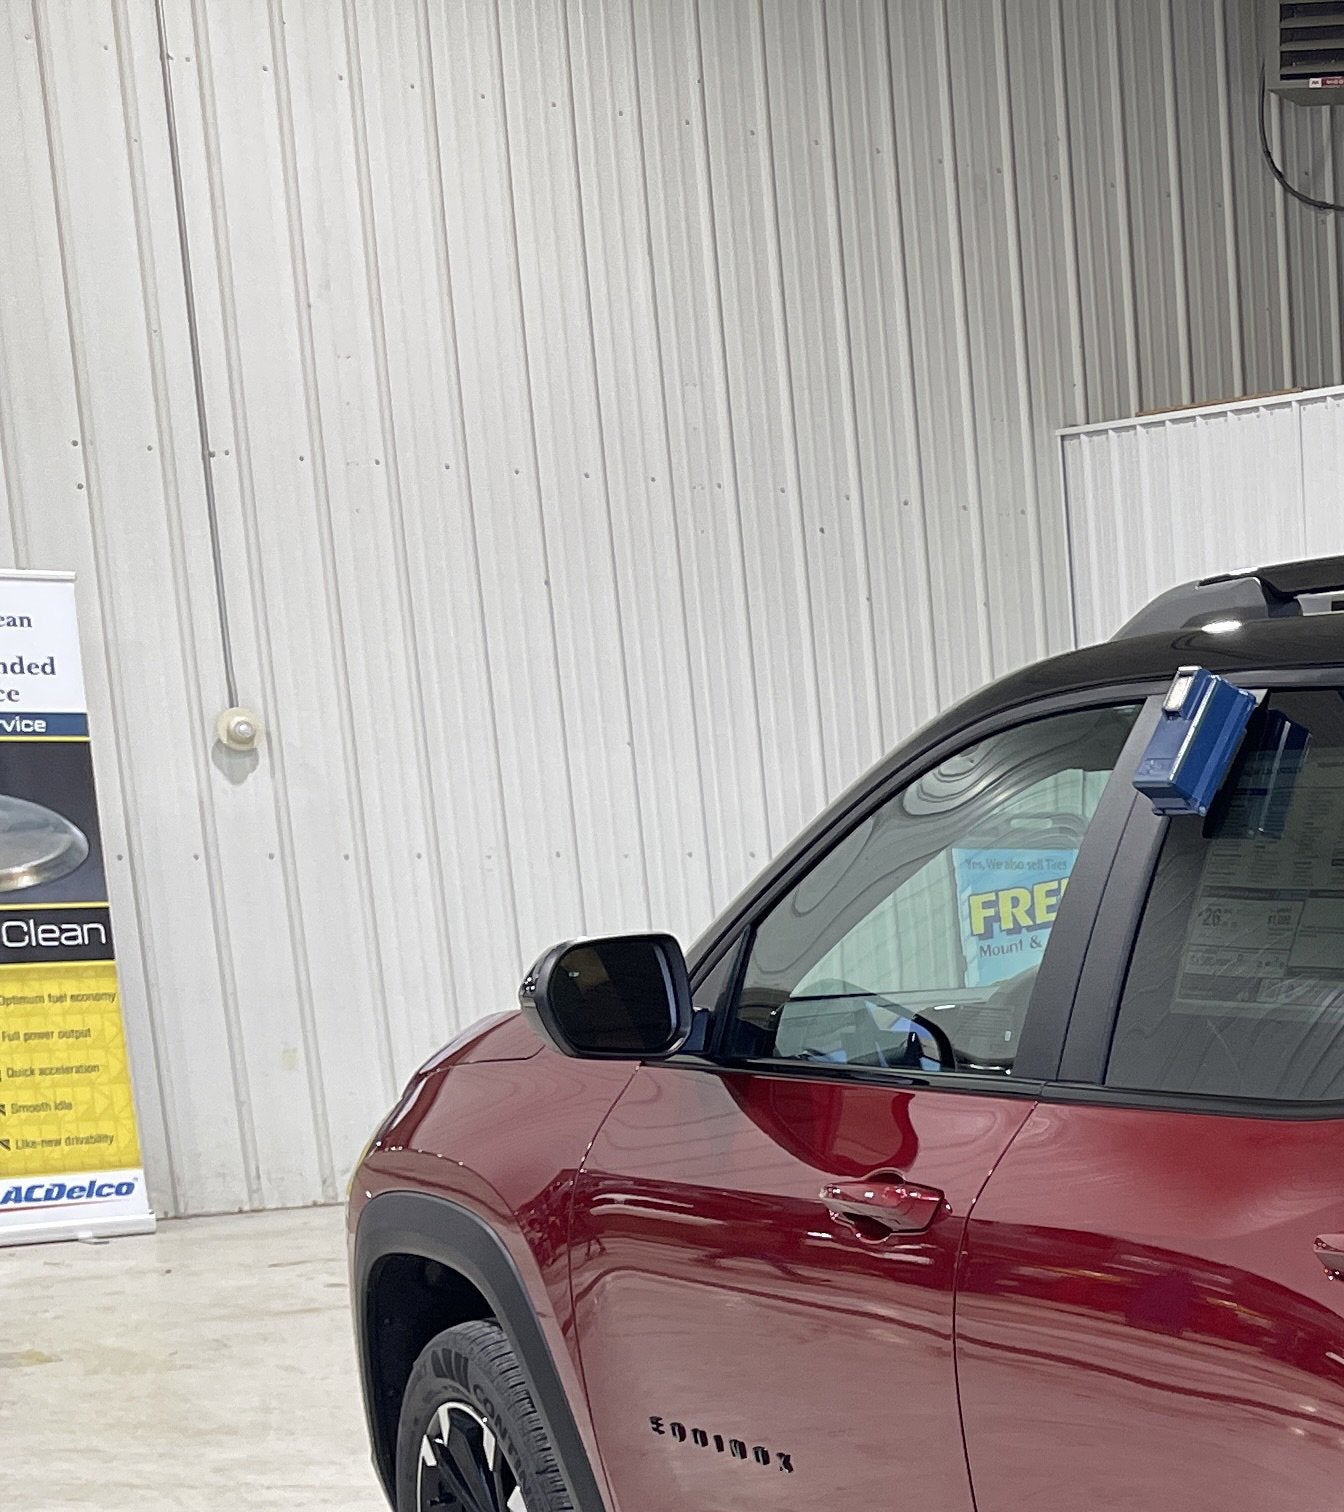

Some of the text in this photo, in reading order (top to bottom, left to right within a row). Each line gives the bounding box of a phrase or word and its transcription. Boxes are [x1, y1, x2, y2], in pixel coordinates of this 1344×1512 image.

[1003, 858, 1024, 870] also
[1027, 858, 1043, 870] sell
[1044, 858, 1067, 871] Tires
[968, 877, 1070, 938] FRE
[1, 919, 107, 948] Clean
[979, 935, 1043, 958] Mount &
[47, 993, 68, 1003] fuel
[70, 992, 117, 1003] economy
[1, 1027, 91, 1043] Full power output
[6, 1064, 100, 1079] Quick acceleration
[10, 1102, 52, 1115] Smooth
[15, 1133, 114, 1151] Like-new drivability
[0, 1179, 135, 1205] ACDelco
[648, 1415, 794, 1474] EQUINOX
